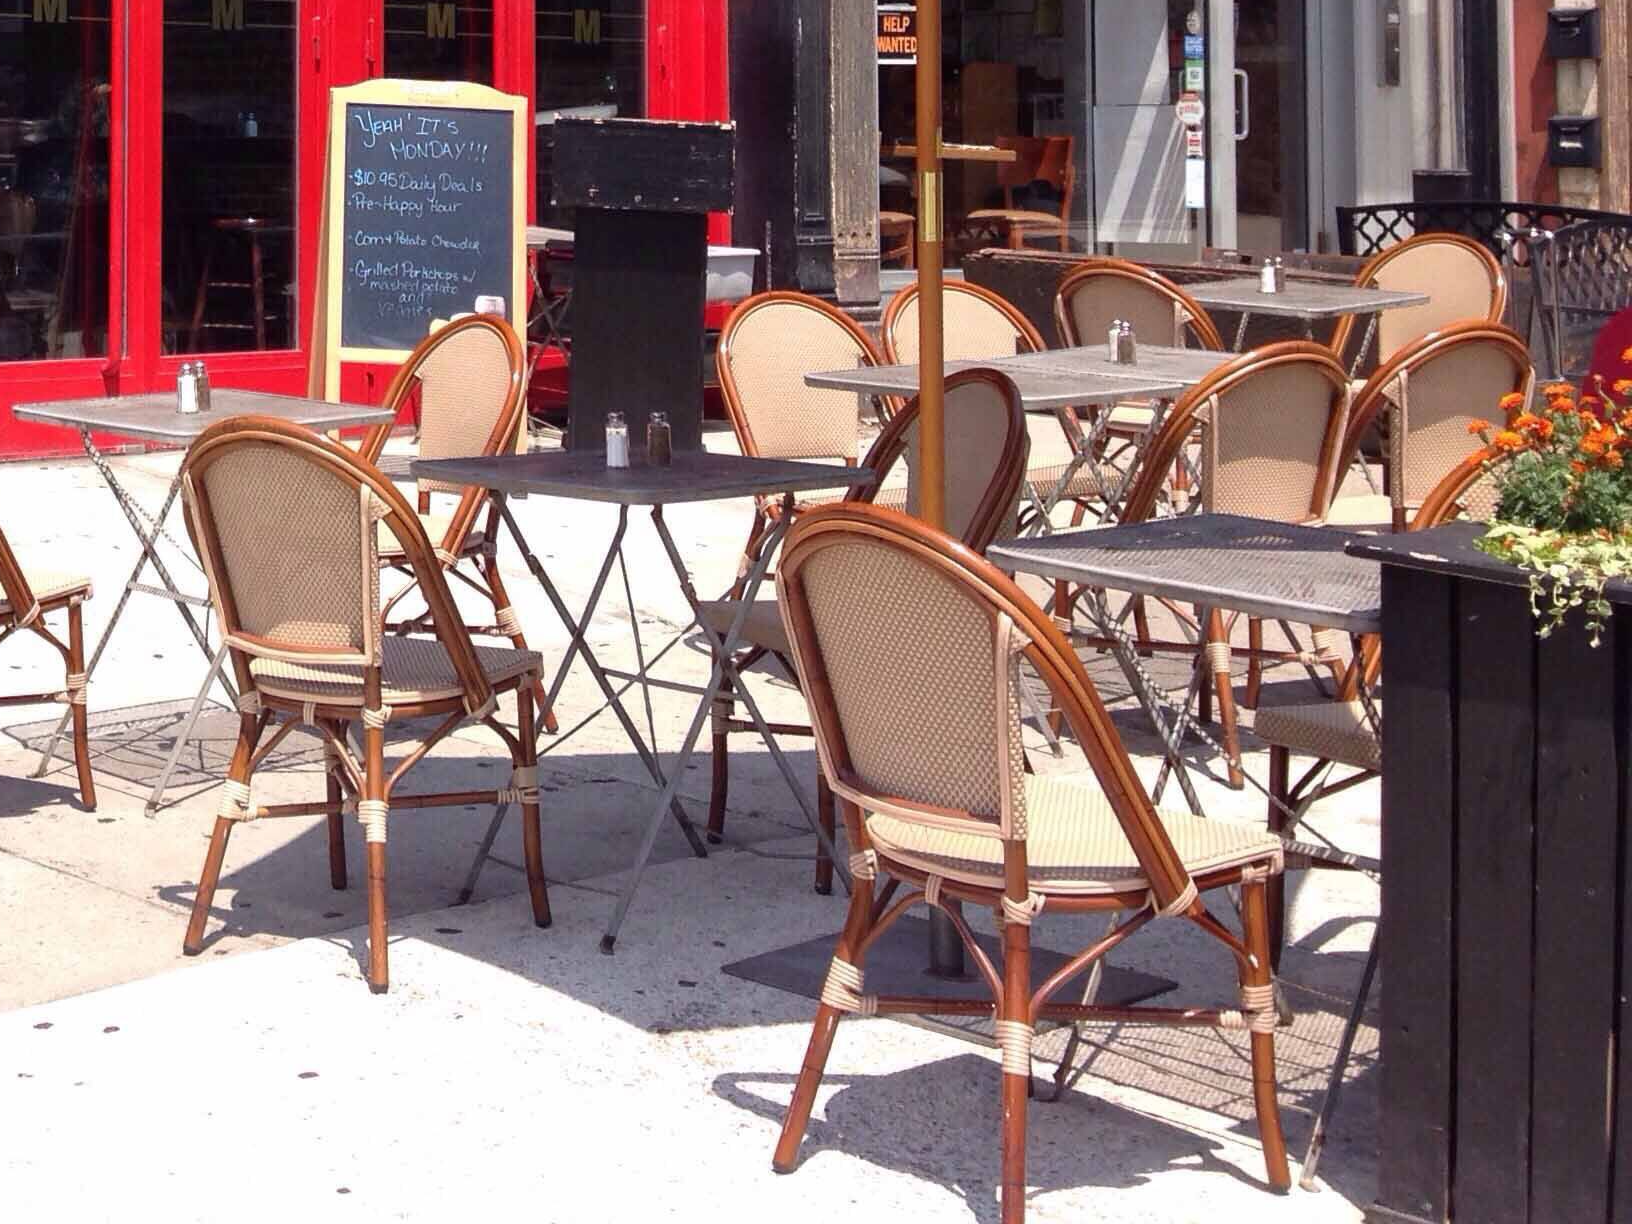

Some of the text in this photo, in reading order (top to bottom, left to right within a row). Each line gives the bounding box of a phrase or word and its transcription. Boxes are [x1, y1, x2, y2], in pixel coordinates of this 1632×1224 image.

[426, 2, 457, 40] M
[574, 9, 601, 44] M
[883, 16, 911, 33] HELP
[876, 36, 918, 53] WANTED
[389, 138, 488, 164] MONDAY!!!
[398, 172, 437, 203] Daily
[439, 173, 483, 192] Deals
[430, 198, 463, 213] Hour
[354, 259, 399, 287] Grilled
[399, 293, 425, 304] and
